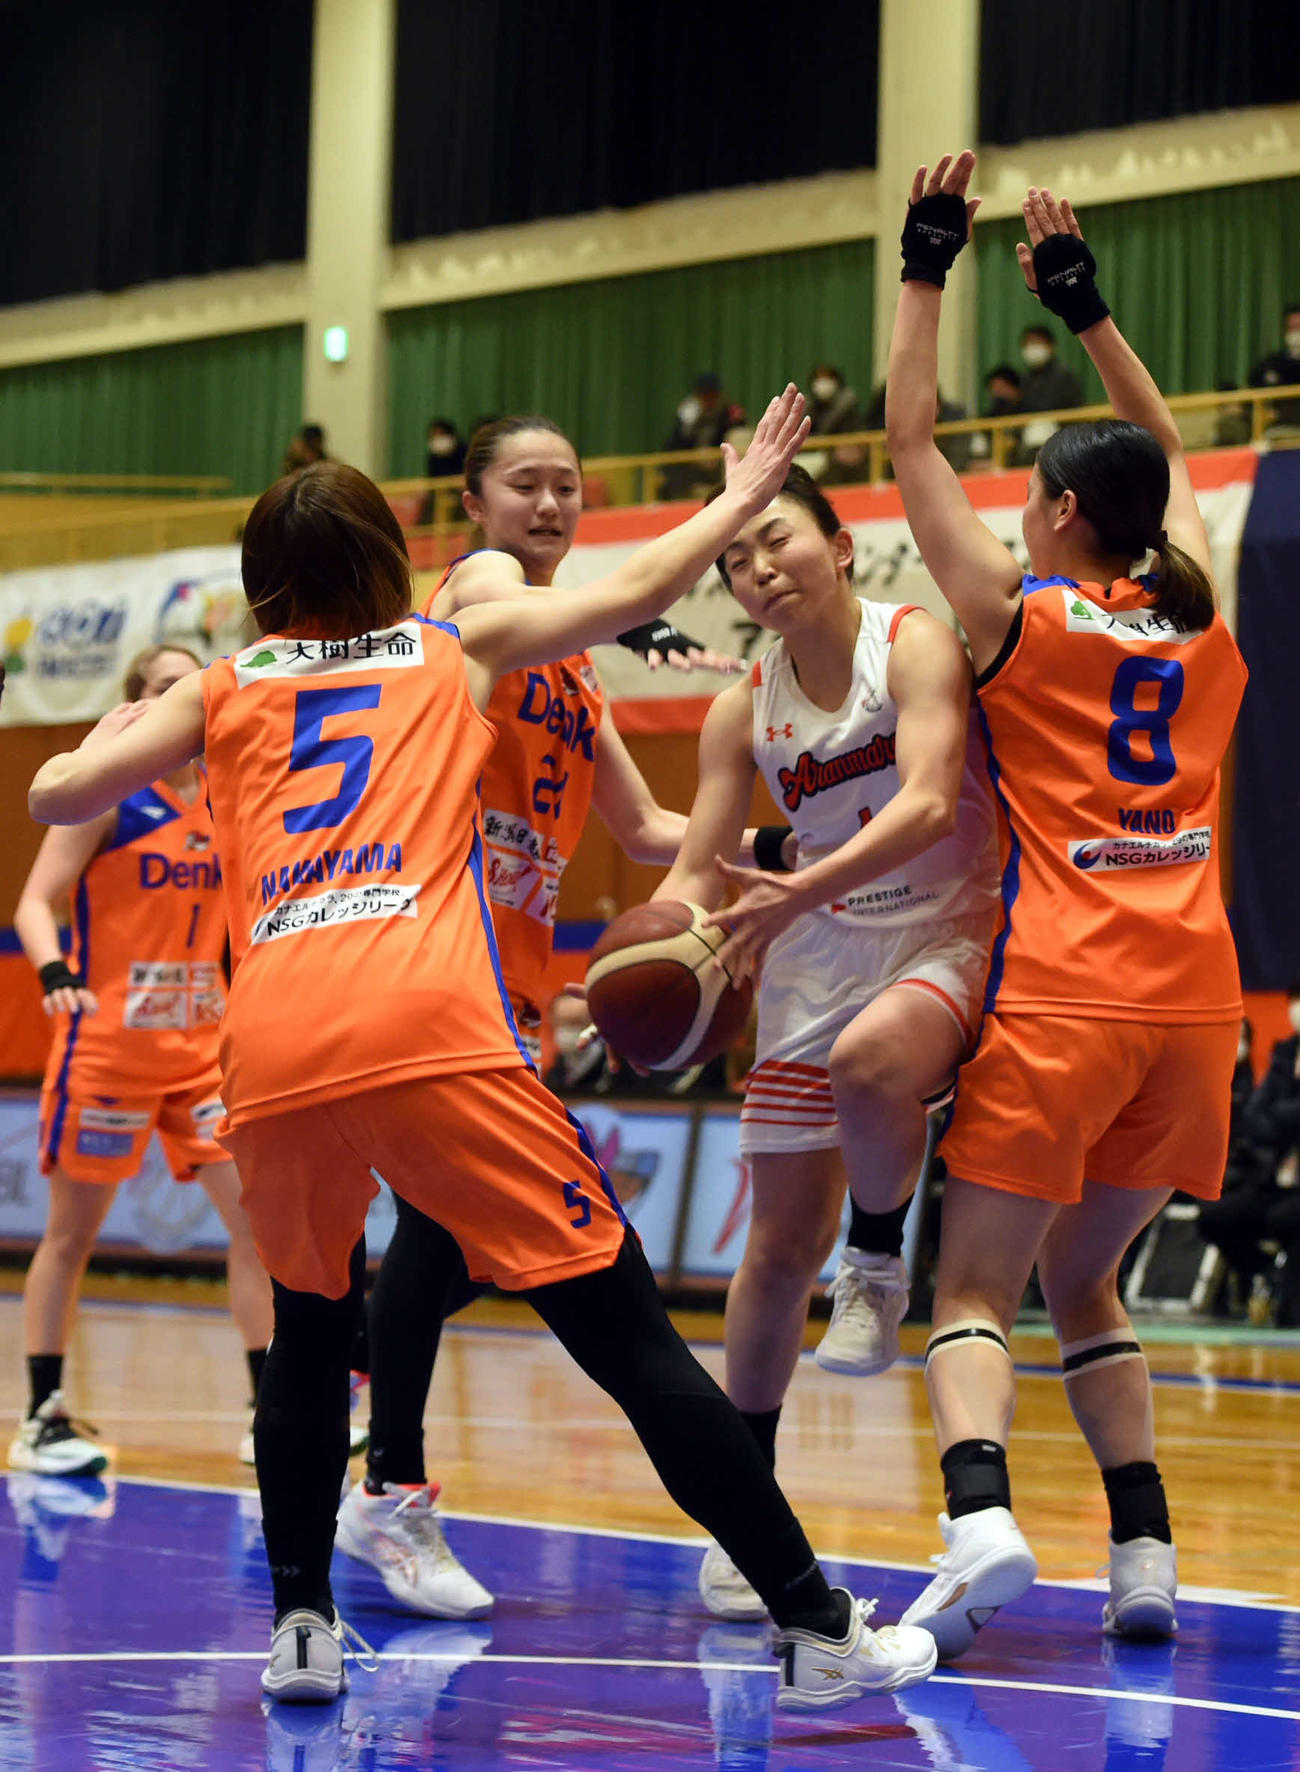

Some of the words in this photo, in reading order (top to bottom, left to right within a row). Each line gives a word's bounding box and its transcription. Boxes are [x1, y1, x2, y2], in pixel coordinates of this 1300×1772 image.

[1107, 655, 1184, 786] 8
[283, 683, 382, 834] 5
[1117, 807, 1176, 834] YANO
[1105, 842, 1211, 867] NSGカレッジリ
[261, 842, 403, 906] NAKAYAMA
[847, 885, 912, 906] PRESTIGE
[852, 891, 940, 916] INTERNATIONAL
[563, 1179, 592, 1229] 5
